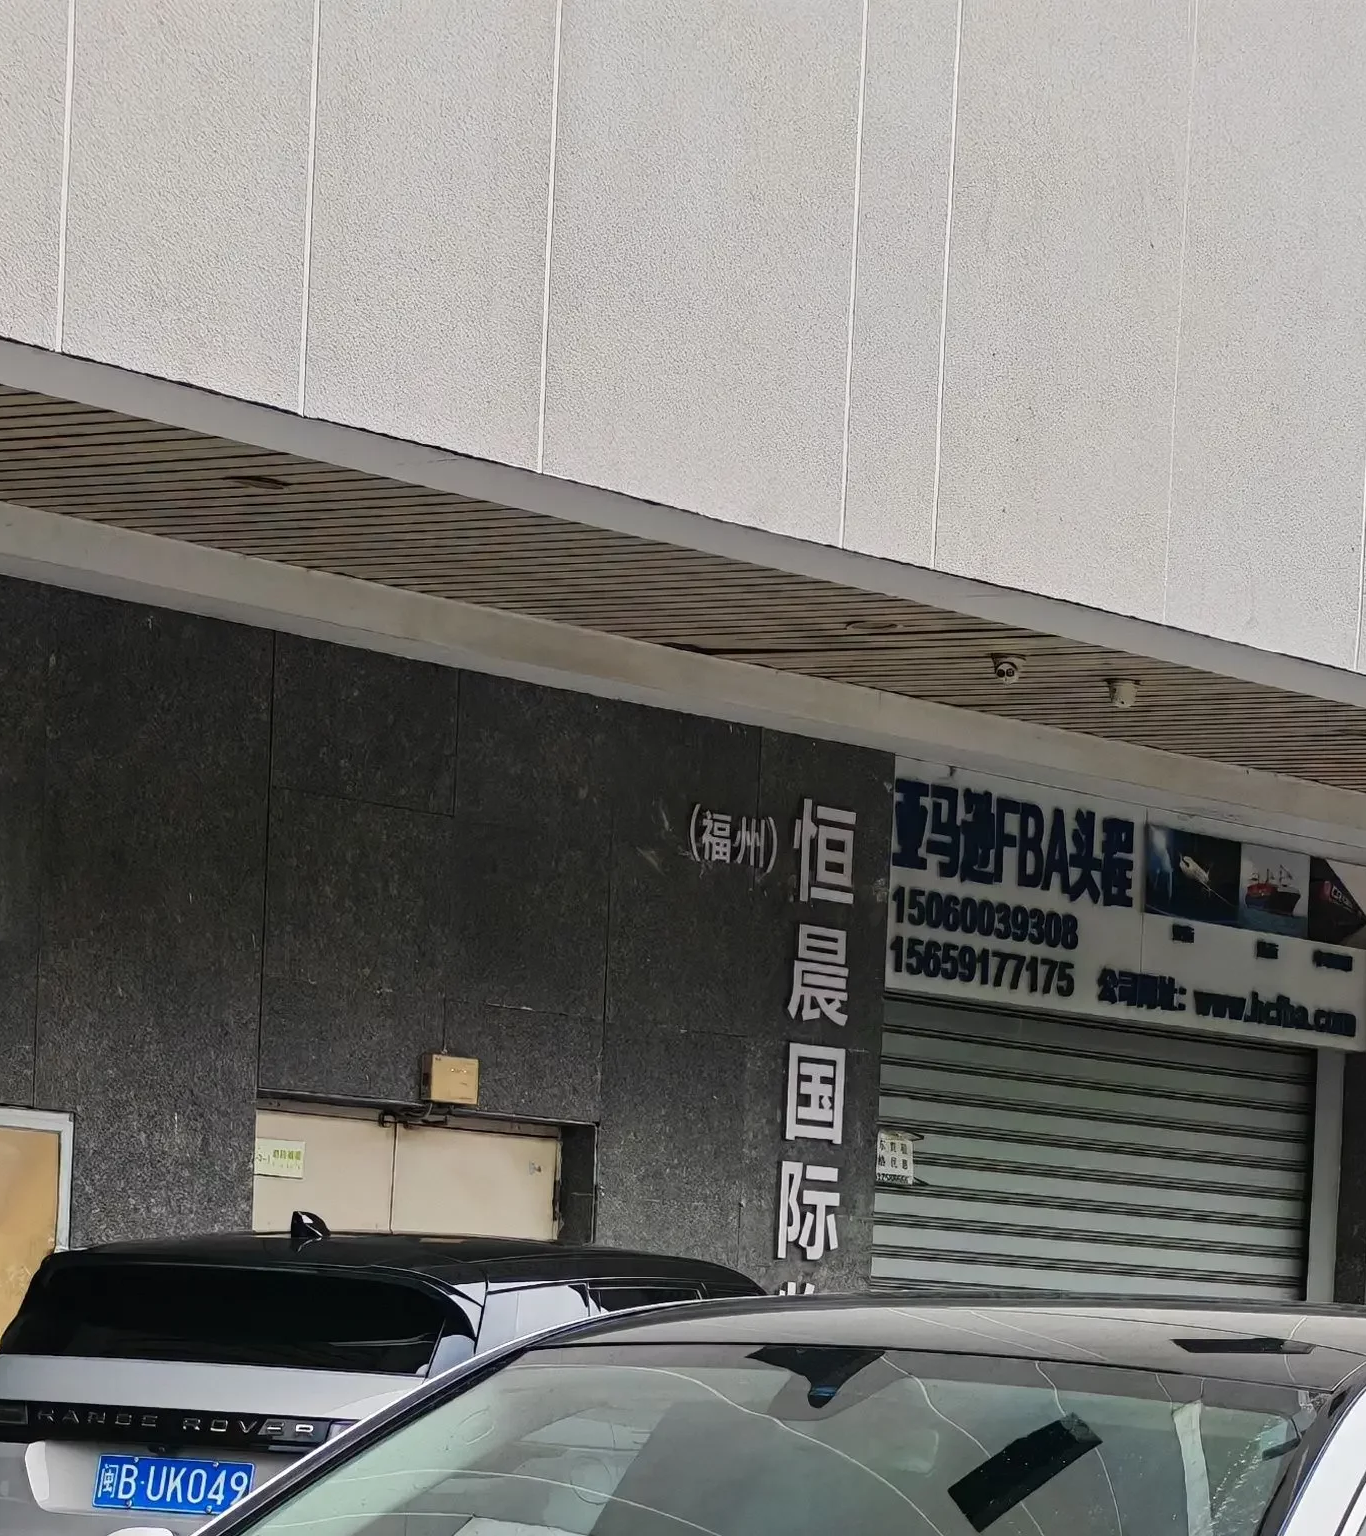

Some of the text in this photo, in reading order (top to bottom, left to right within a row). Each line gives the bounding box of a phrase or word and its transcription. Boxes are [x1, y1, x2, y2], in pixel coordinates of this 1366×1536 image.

[892, 886, 1080, 951] 15060039308
[777, 798, 857, 1296] 恒晨国际
[182, 1417, 315, 1438] ROVER
